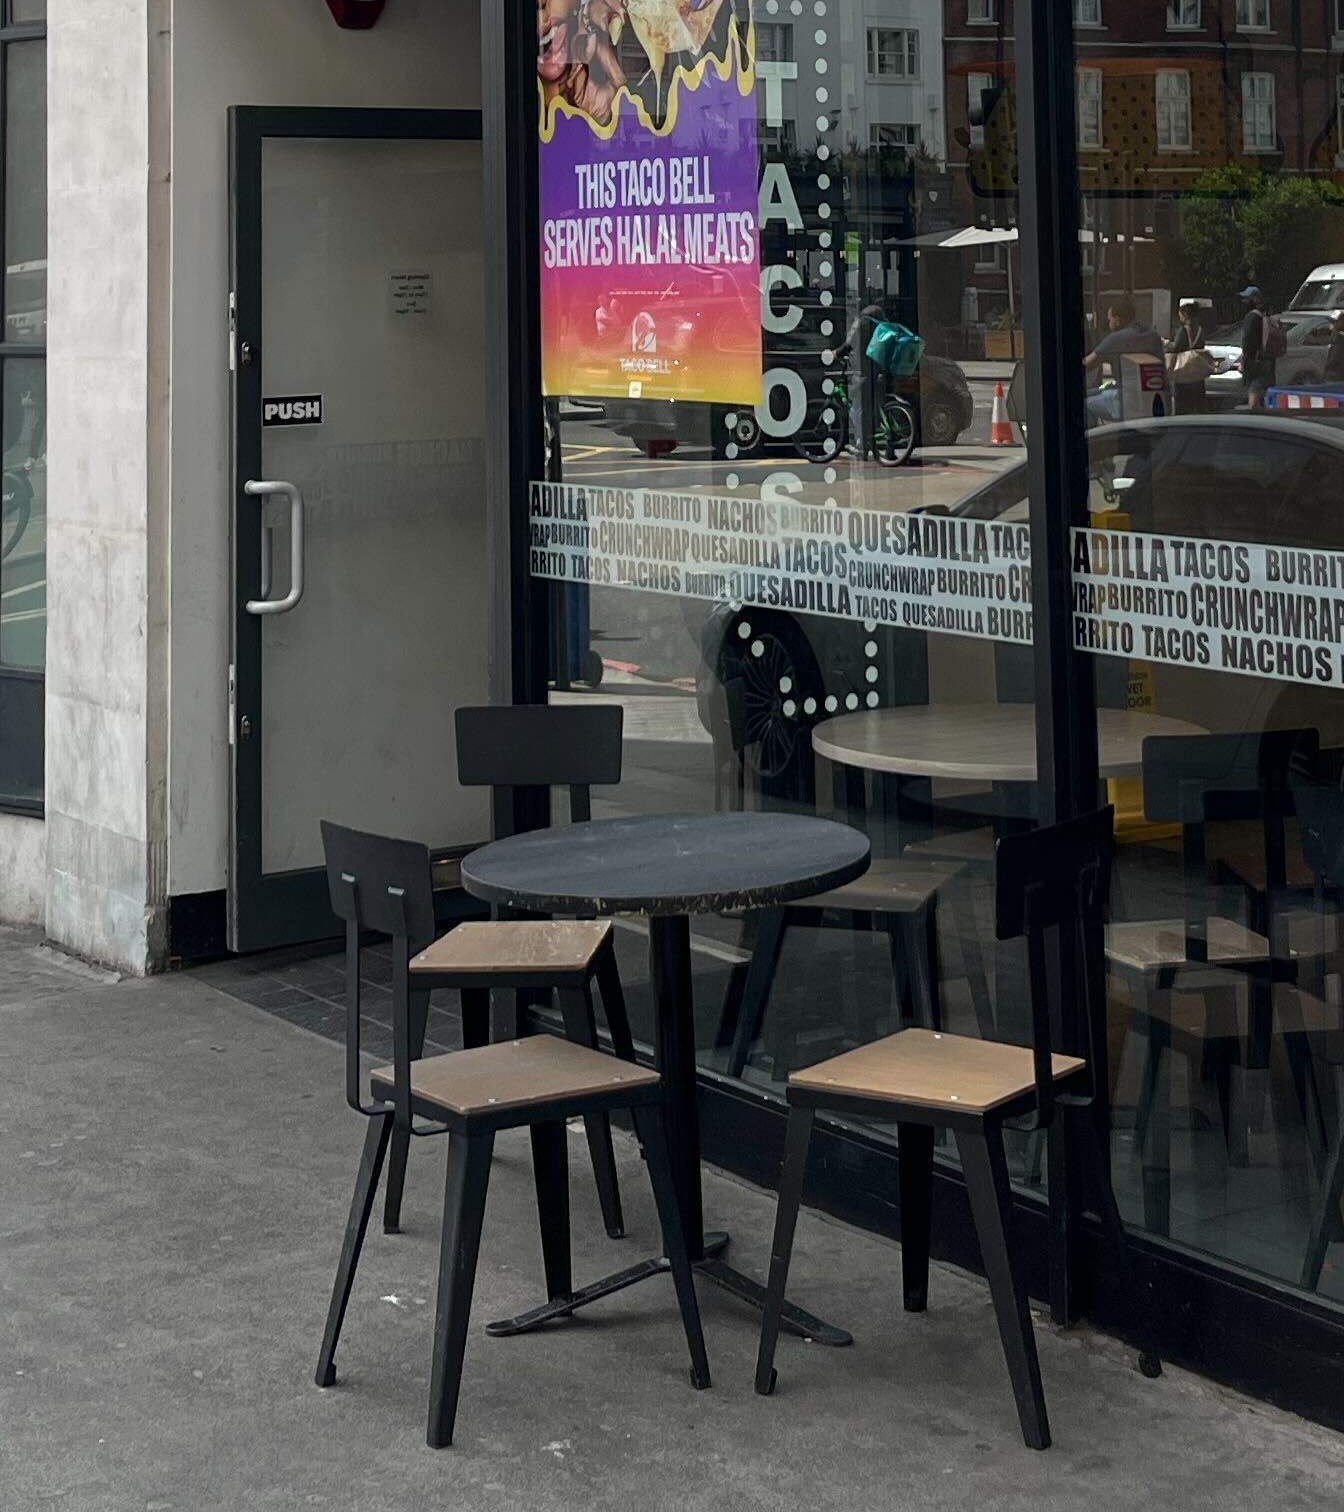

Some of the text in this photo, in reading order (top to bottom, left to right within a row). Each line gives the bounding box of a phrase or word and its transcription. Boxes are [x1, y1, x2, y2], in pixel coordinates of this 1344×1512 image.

[575, 156, 715, 209] THIS TACO BELL
[544, 211, 755, 269] SERVES HALAL MEATS
[264, 401, 319, 420] PUSH
[531, 484, 588, 521] ADILLA
[588, 489, 634, 519] TACOS
[643, 494, 702, 523] BURRITO
[707, 499, 777, 536] NACHOS
[780, 506, 843, 536] BURRITO
[847, 511, 989, 564] QUESADILLA
[551, 523, 599, 550] BURRITO
[599, 521, 690, 563] CRUNCHWRAP
[691, 534, 781, 570] QUESADILLA
[782, 537, 848, 579] TACOS
[849, 559, 935, 596] CRUNCHWRAP
[937, 566, 1005, 601] BURRITO
[1073, 532, 1169, 583] ADILLA
[1170, 540, 1250, 584] TACOS
[531, 549, 566, 576] RRITO
[571, 554, 611, 582] TACOS
[616, 559, 681, 592] NACHOS
[685, 572, 726, 598] BURRITO
[730, 570, 851, 616] QUESADILLA
[855, 595, 897, 622] TACOS
[902, 601, 984, 634] QUESADILLA
[1108, 582, 1187, 619] BURRITO
[1074, 616, 1133, 654] RRITO
[1142, 624, 1209, 664] TACOS
[1221, 634, 1333, 682] NACHOS
